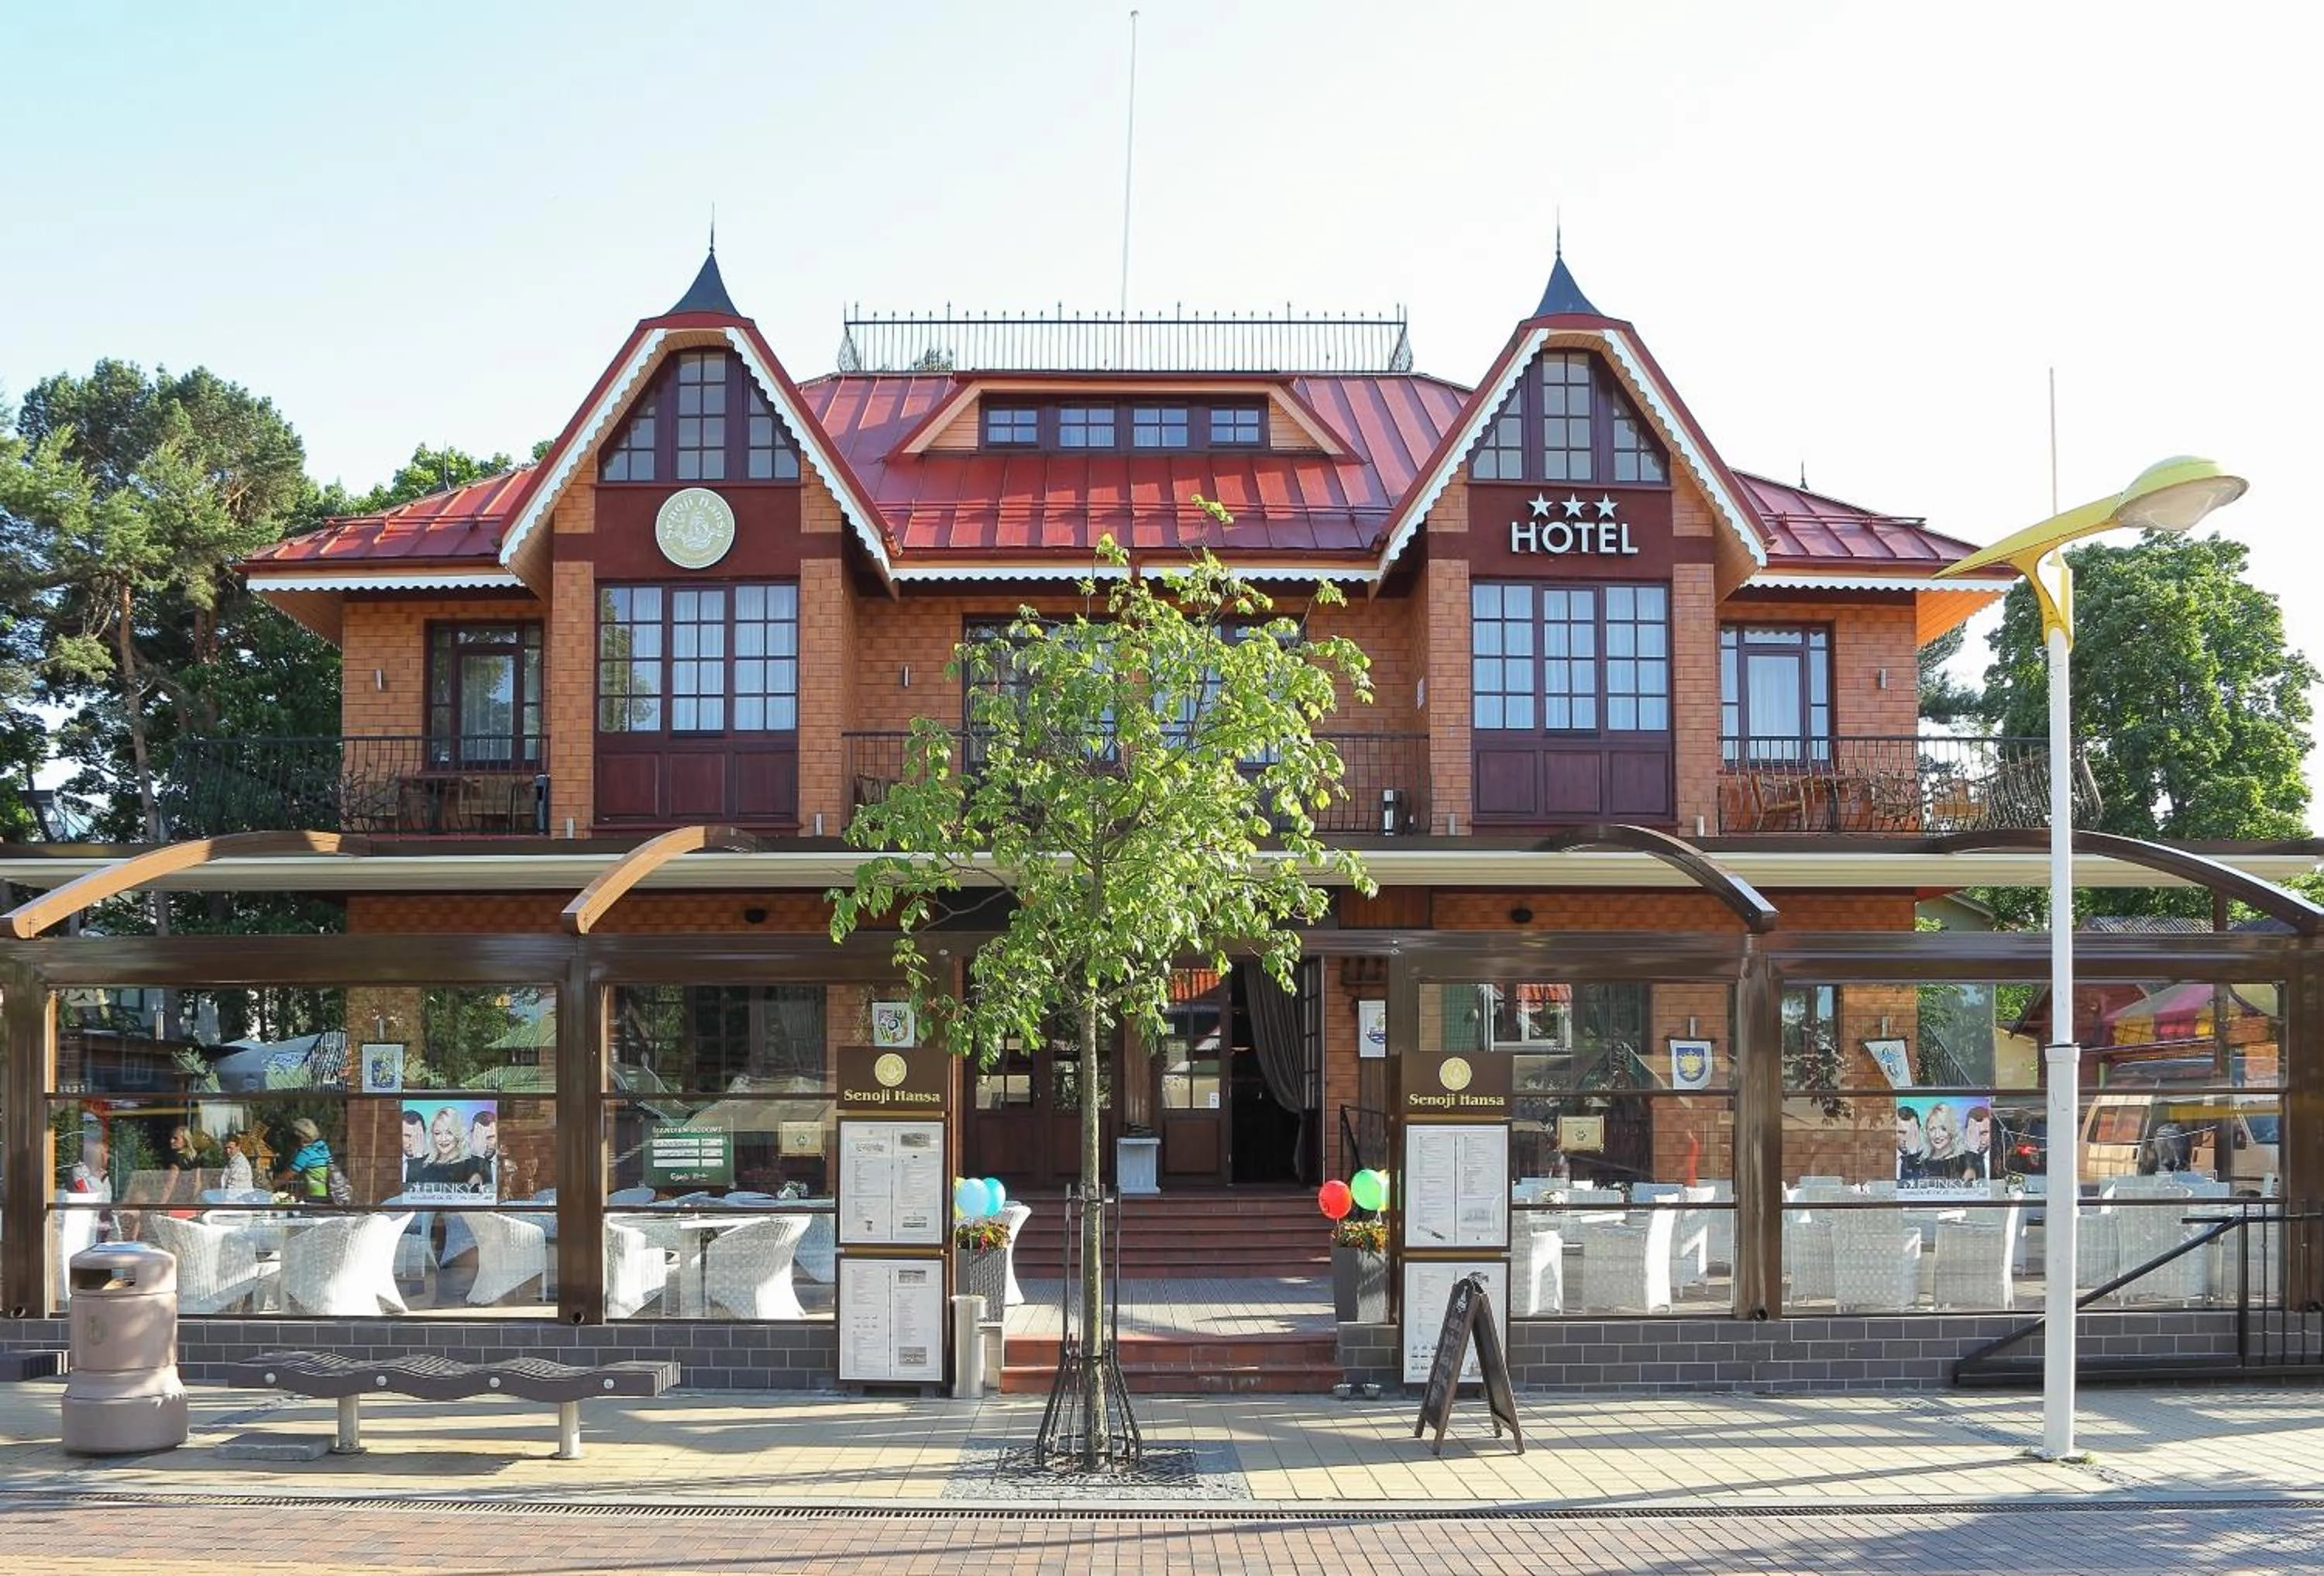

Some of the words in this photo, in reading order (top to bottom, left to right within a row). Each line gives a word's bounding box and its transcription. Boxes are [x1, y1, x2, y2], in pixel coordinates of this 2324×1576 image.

[1511, 521, 1639, 554] HOTEL
[844, 1089, 891, 1104] Senoji
[895, 1090, 942, 1103] Hansa
[1409, 1093, 1456, 1108] Senoji
[1459, 1094, 1505, 1106] Hansa
[424, 1182, 474, 1193] FUNKY
[1917, 1179, 1966, 1189] FUNKY
